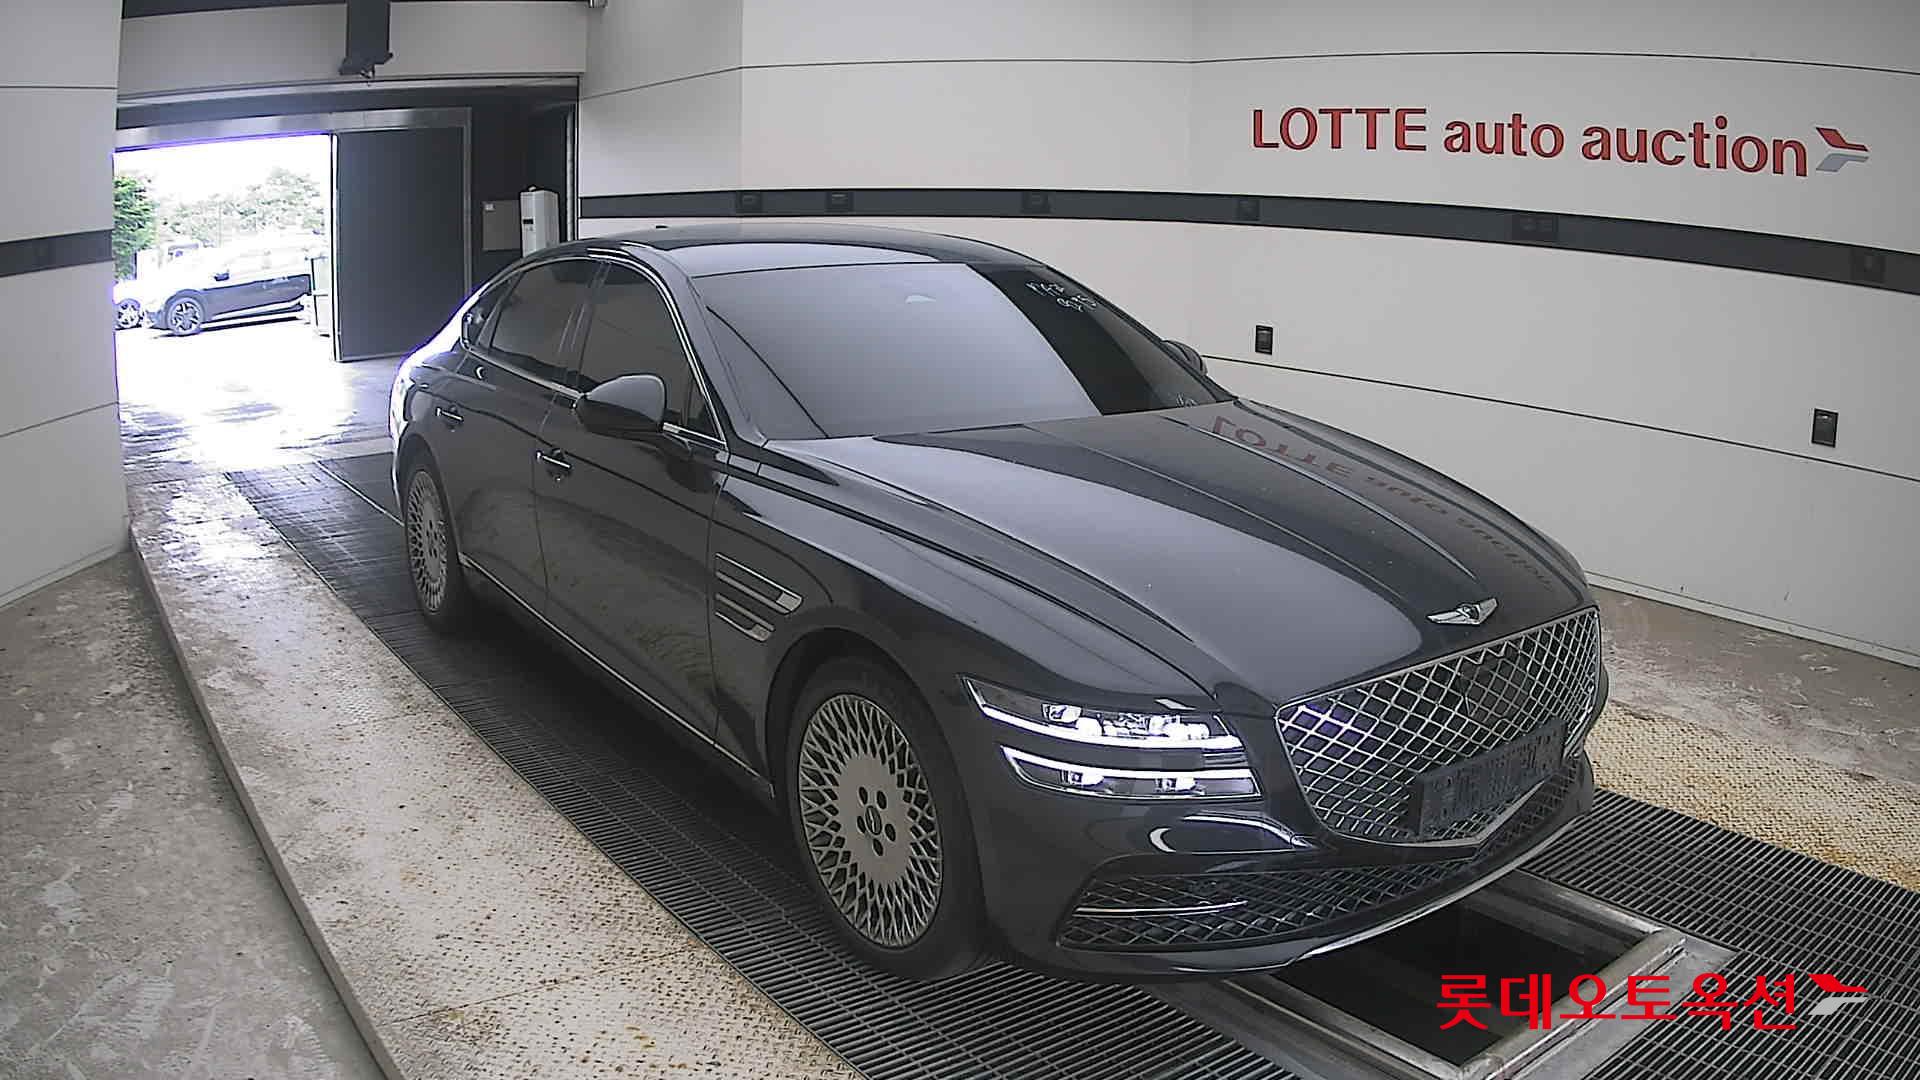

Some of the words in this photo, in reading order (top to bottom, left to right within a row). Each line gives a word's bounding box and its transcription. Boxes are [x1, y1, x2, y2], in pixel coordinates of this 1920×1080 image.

[1253, 107, 1428, 151] LOTTE
[1443, 113, 1565, 158] auto
[1581, 115, 1808, 177] auction
